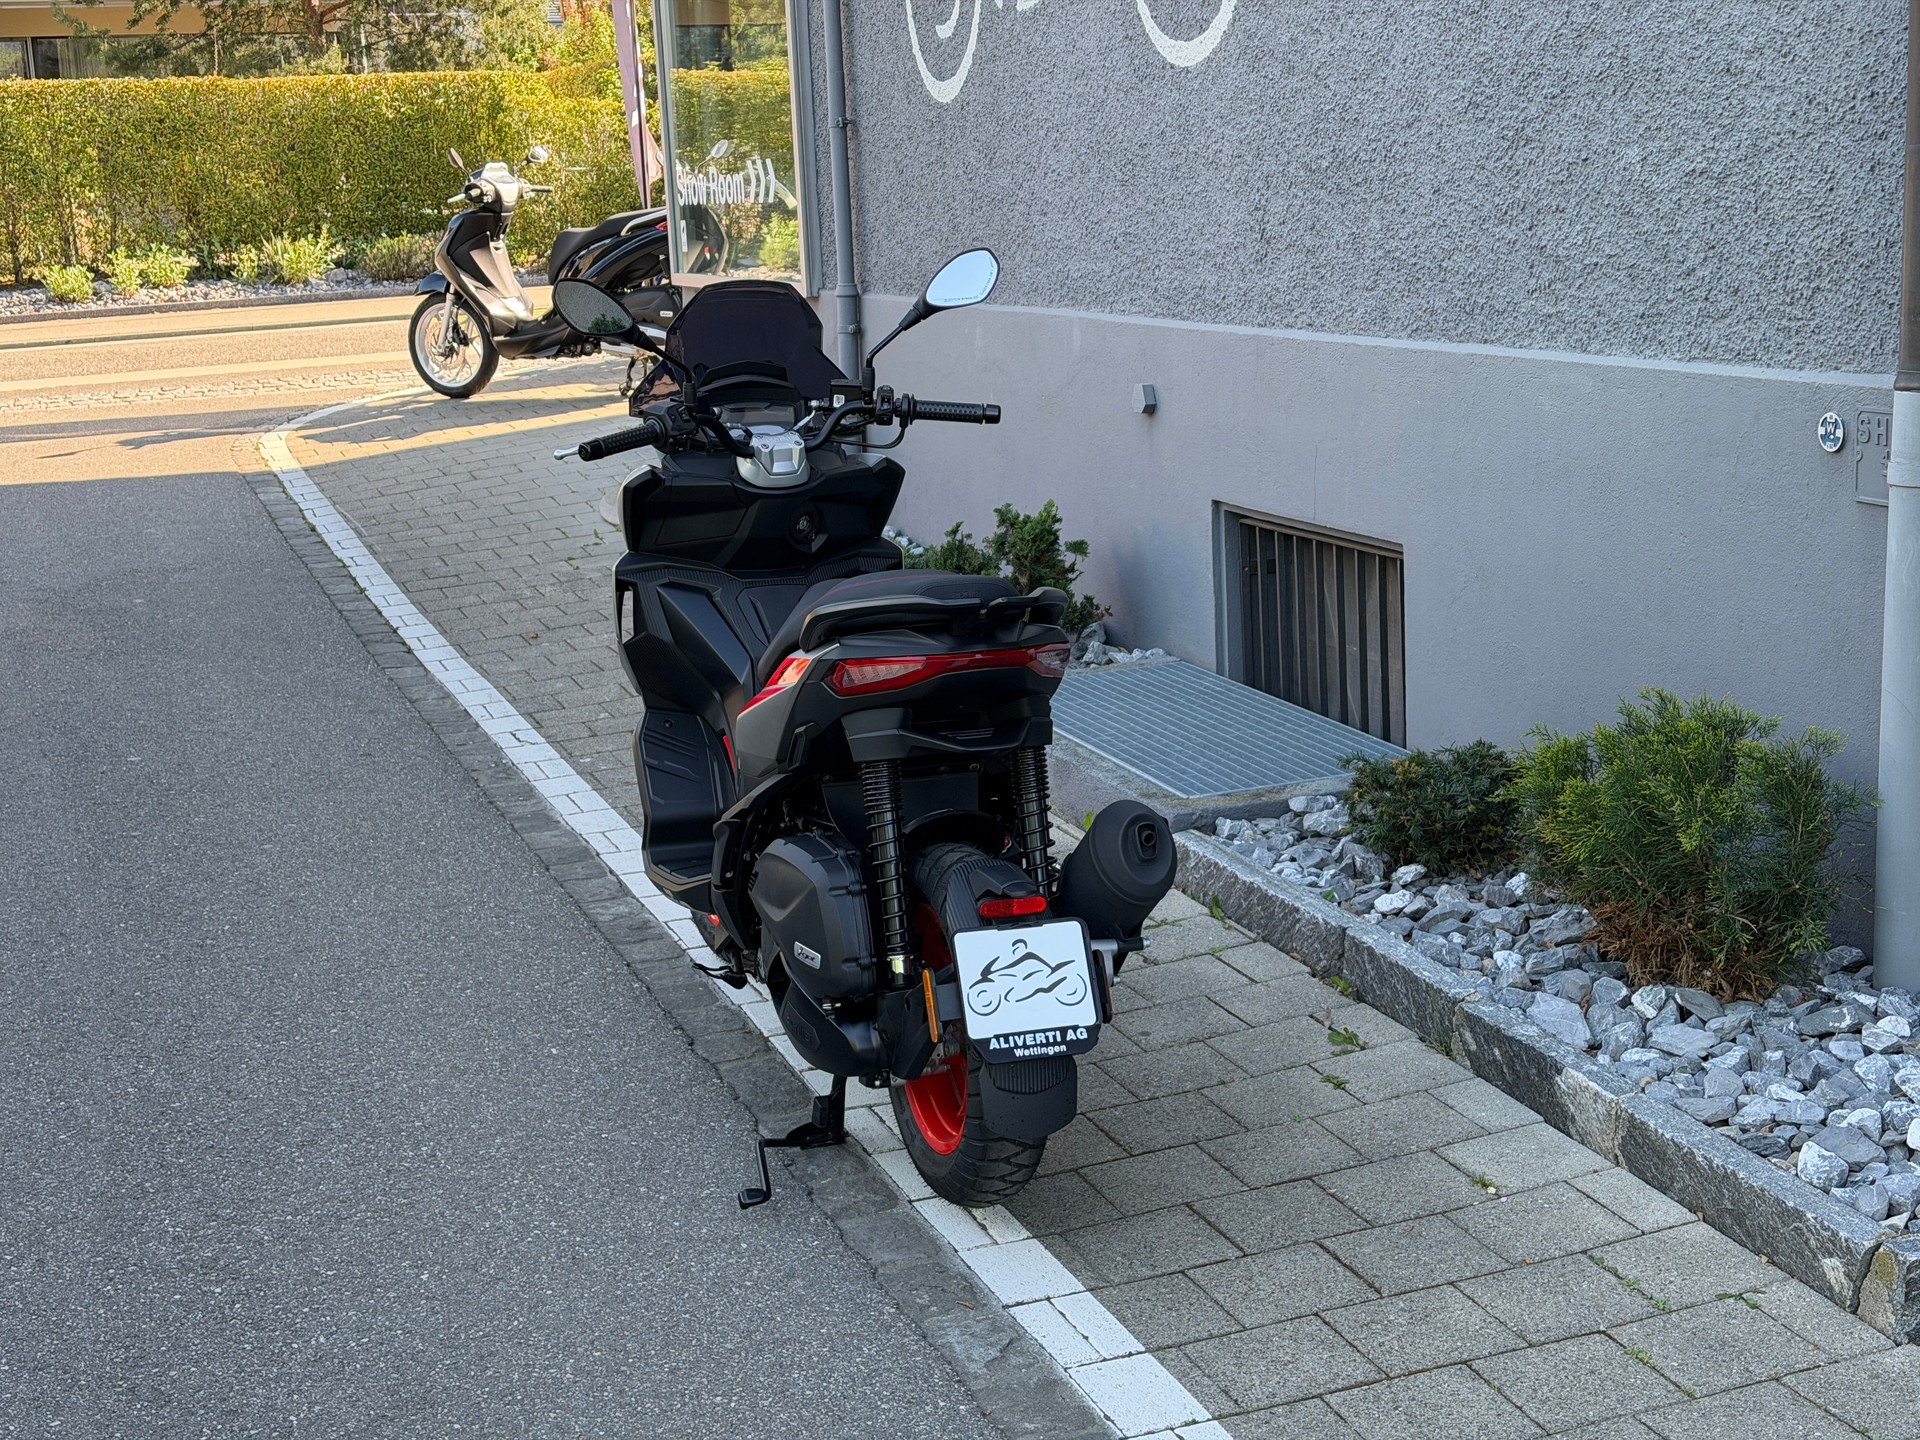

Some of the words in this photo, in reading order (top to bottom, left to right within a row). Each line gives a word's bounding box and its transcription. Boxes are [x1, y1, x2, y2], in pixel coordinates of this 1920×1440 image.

[677, 168, 707, 206] Show
[709, 166, 745, 205] Room
[989, 1030, 1061, 1050] ALIVERTI
[1066, 1027, 1088, 1041] AG
[1014, 1044, 1067, 1057] Wettingen
